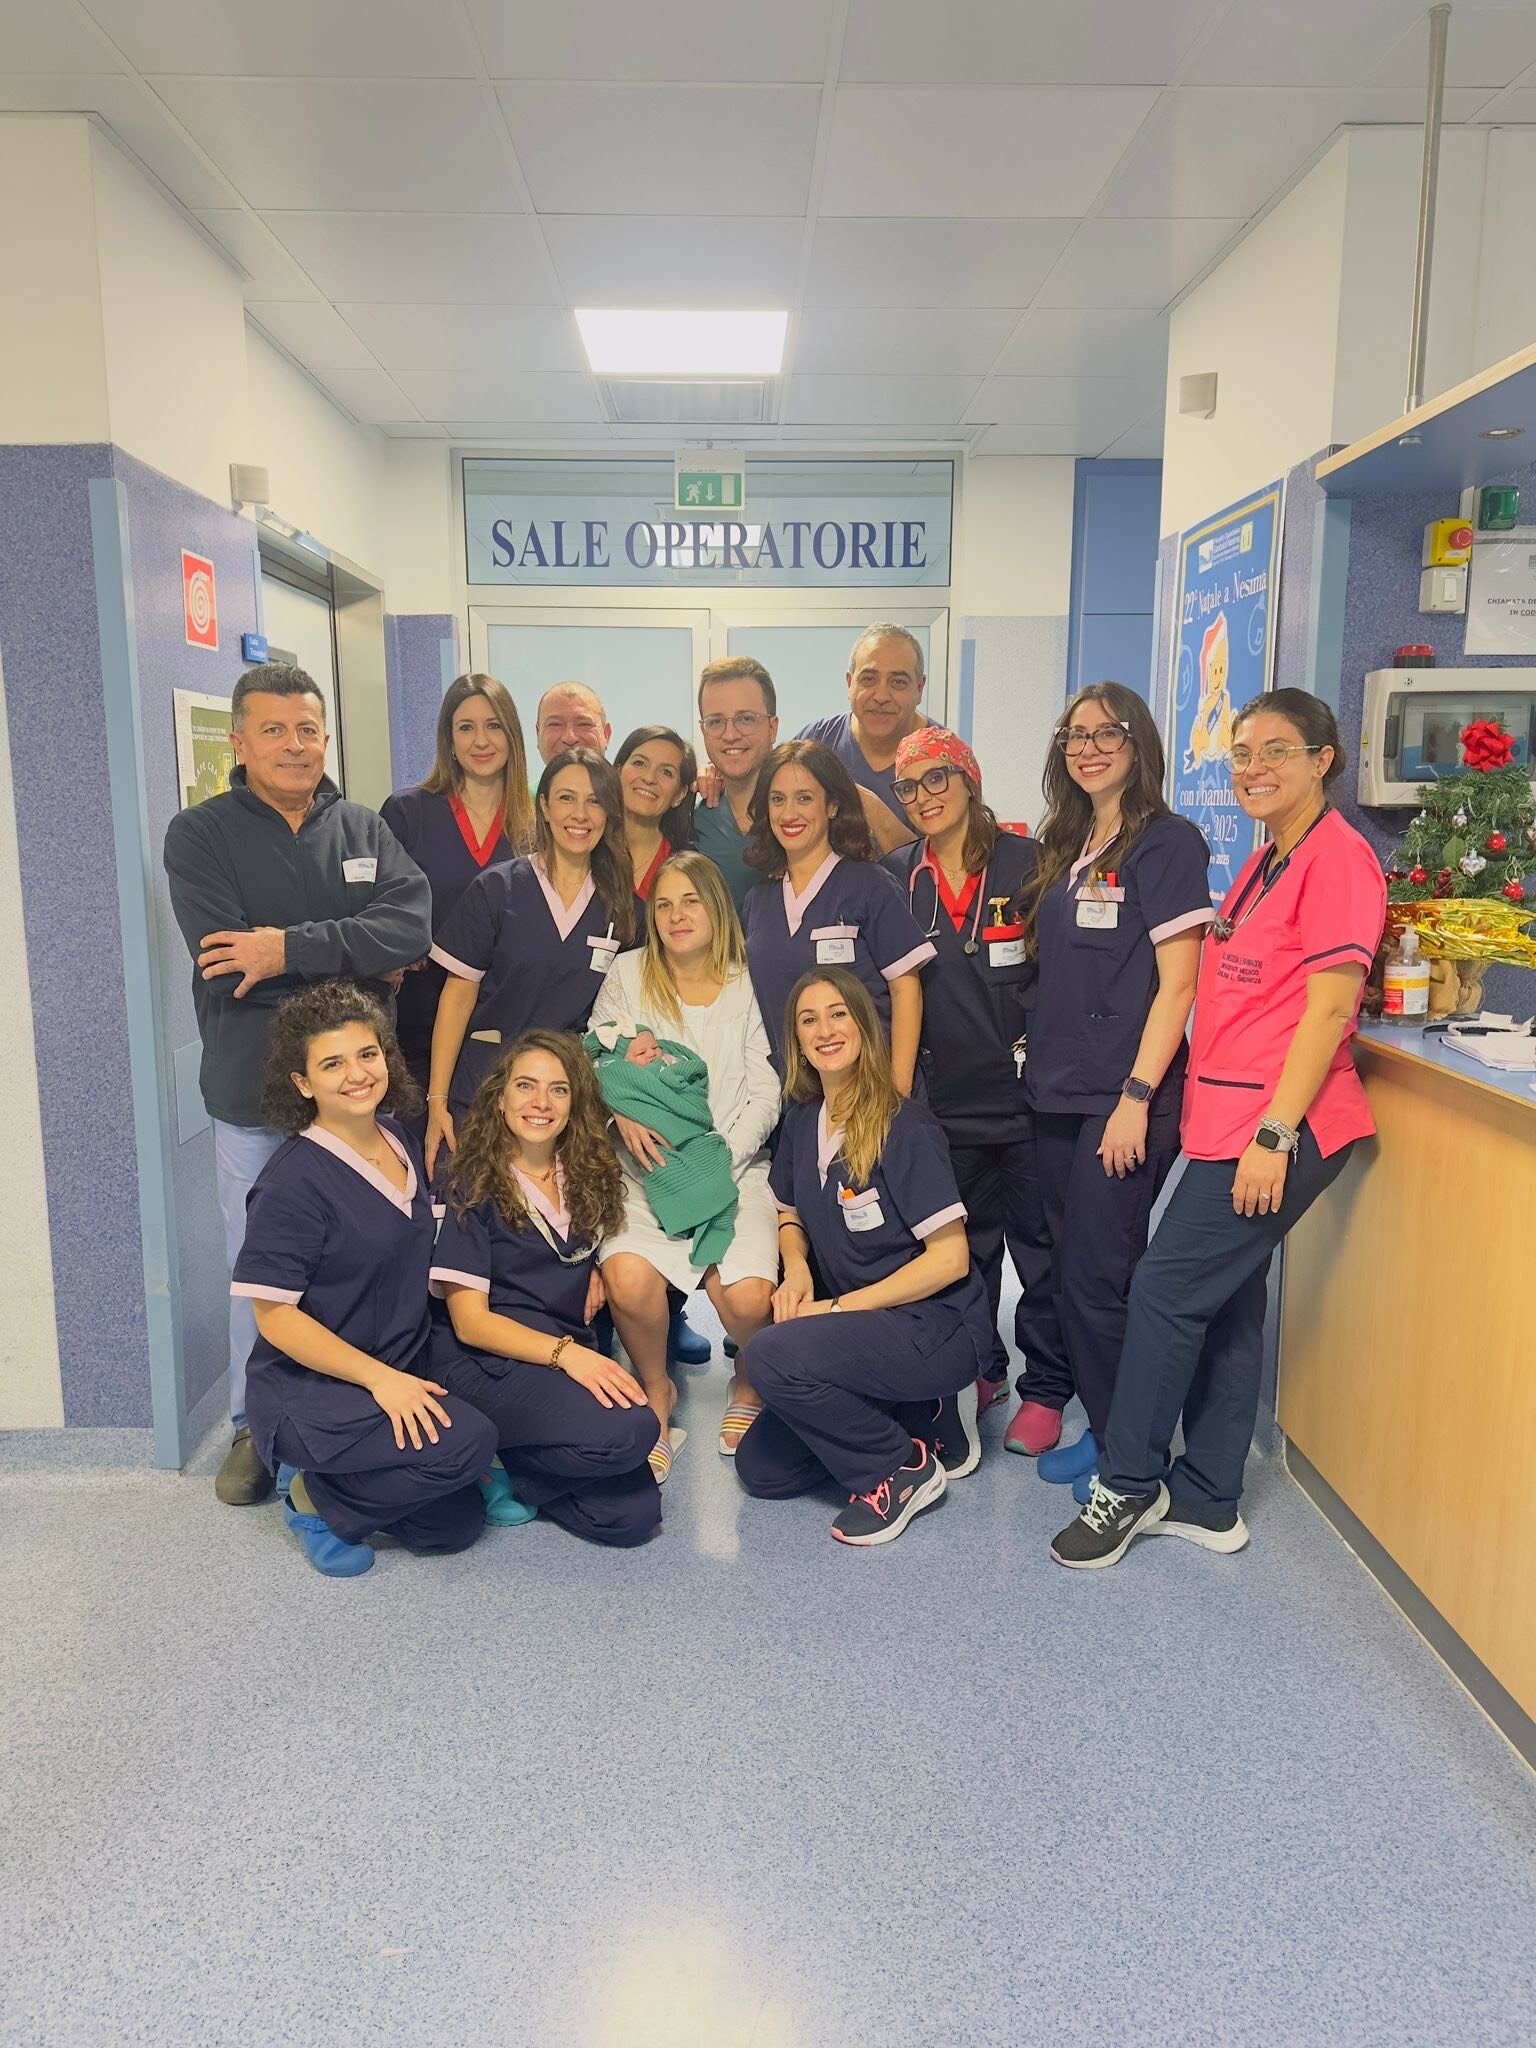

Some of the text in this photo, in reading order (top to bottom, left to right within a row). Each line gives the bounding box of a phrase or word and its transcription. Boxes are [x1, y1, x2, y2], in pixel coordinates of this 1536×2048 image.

[492, 519, 928, 569] SALE OPERATORIE
[1197, 583, 1221, 620] Natale
[1224, 587, 1229, 603] a
[1232, 569, 1267, 604] Nesima
[1180, 790, 1194, 807] con
[1213, 814, 1238, 842] 2025
